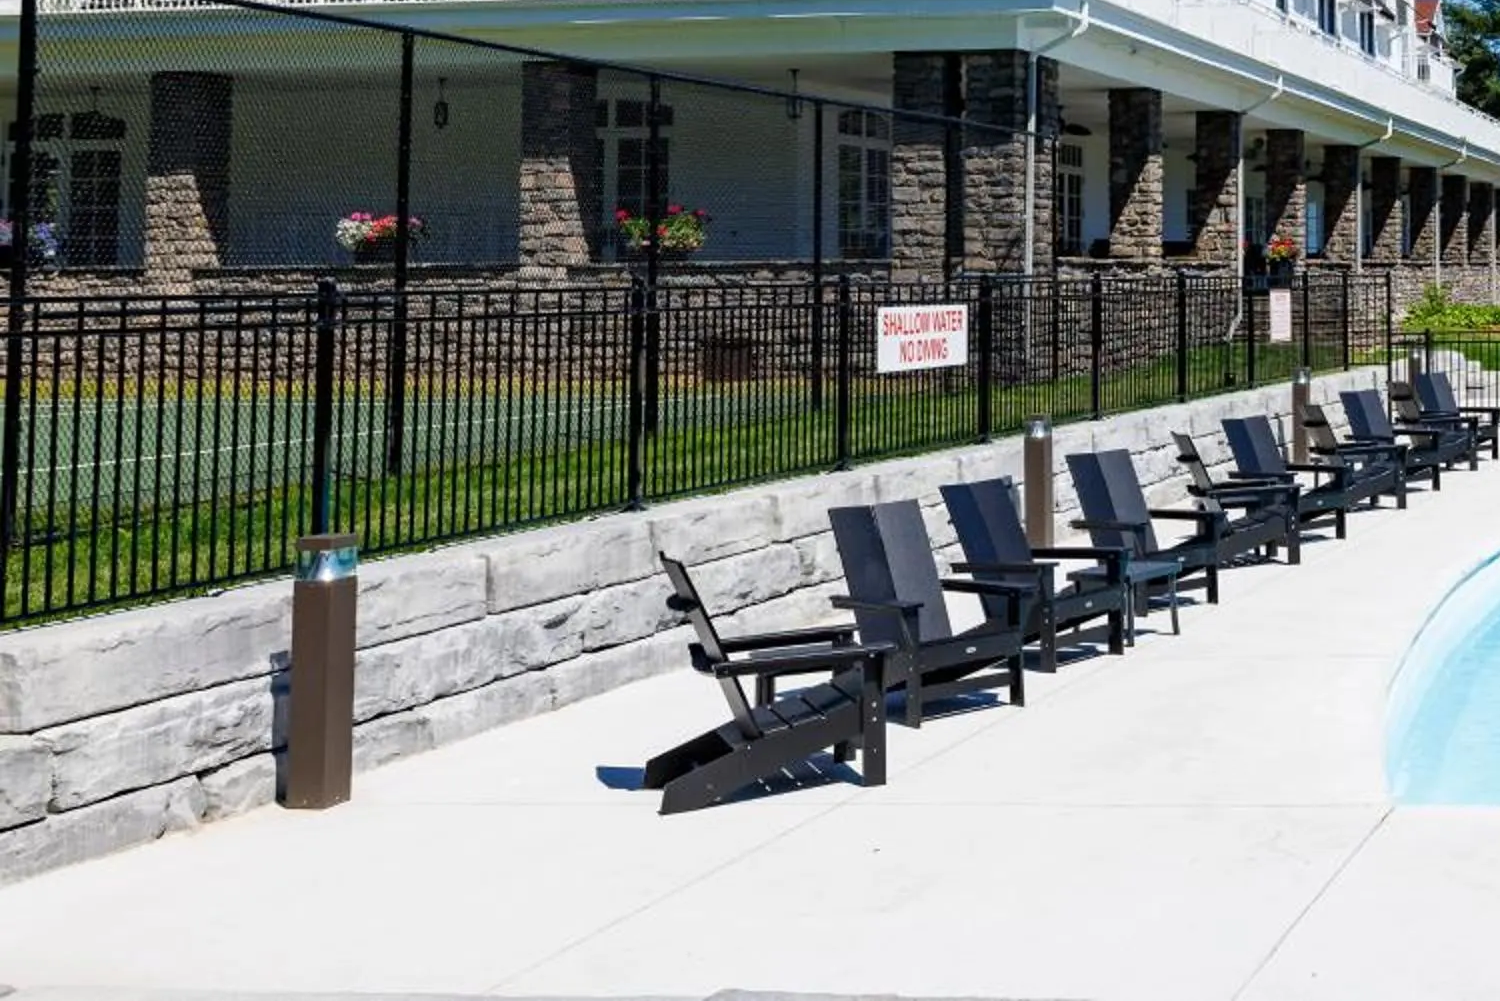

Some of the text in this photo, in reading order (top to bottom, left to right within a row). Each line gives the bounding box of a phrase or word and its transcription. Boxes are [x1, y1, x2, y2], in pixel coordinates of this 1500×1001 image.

[883, 310, 963, 336] SHALLOW WATER
[899, 338, 949, 363] NO DIVING
